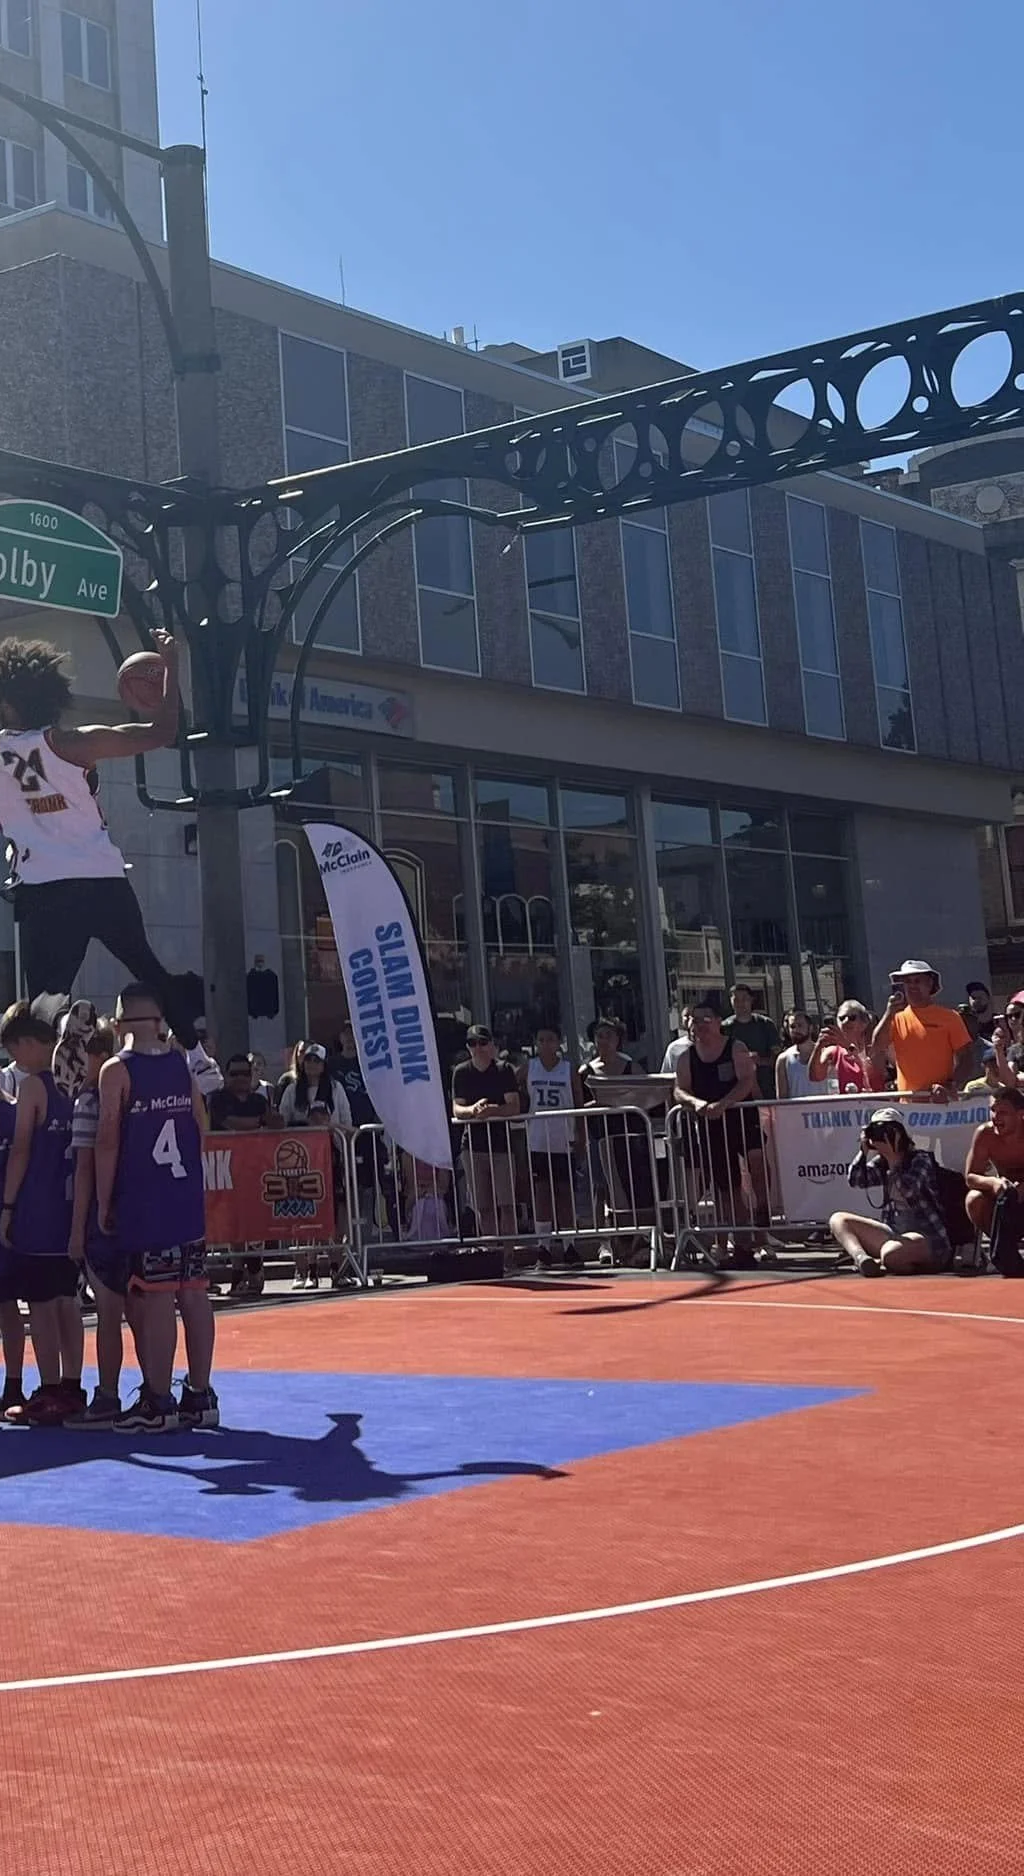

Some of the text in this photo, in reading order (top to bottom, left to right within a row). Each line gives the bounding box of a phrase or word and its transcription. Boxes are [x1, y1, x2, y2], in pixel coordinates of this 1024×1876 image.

[29, 511, 59, 530] 1600
[77, 577, 108, 601] Ave
[318, 848, 371, 874] McClain
[348, 947, 394, 1072] CONTEST
[374, 920, 431, 1086] SLAM DUNK
[150, 1093, 193, 1111] McClain
[536, 1087, 561, 1108] 15
[800, 1110, 853, 1129] THANK
[907, 1110, 942, 1127] OUR
[944, 1106, 990, 1125] MAJO
[152, 1118, 188, 1178] 4
[201, 1149, 234, 1191] NK
